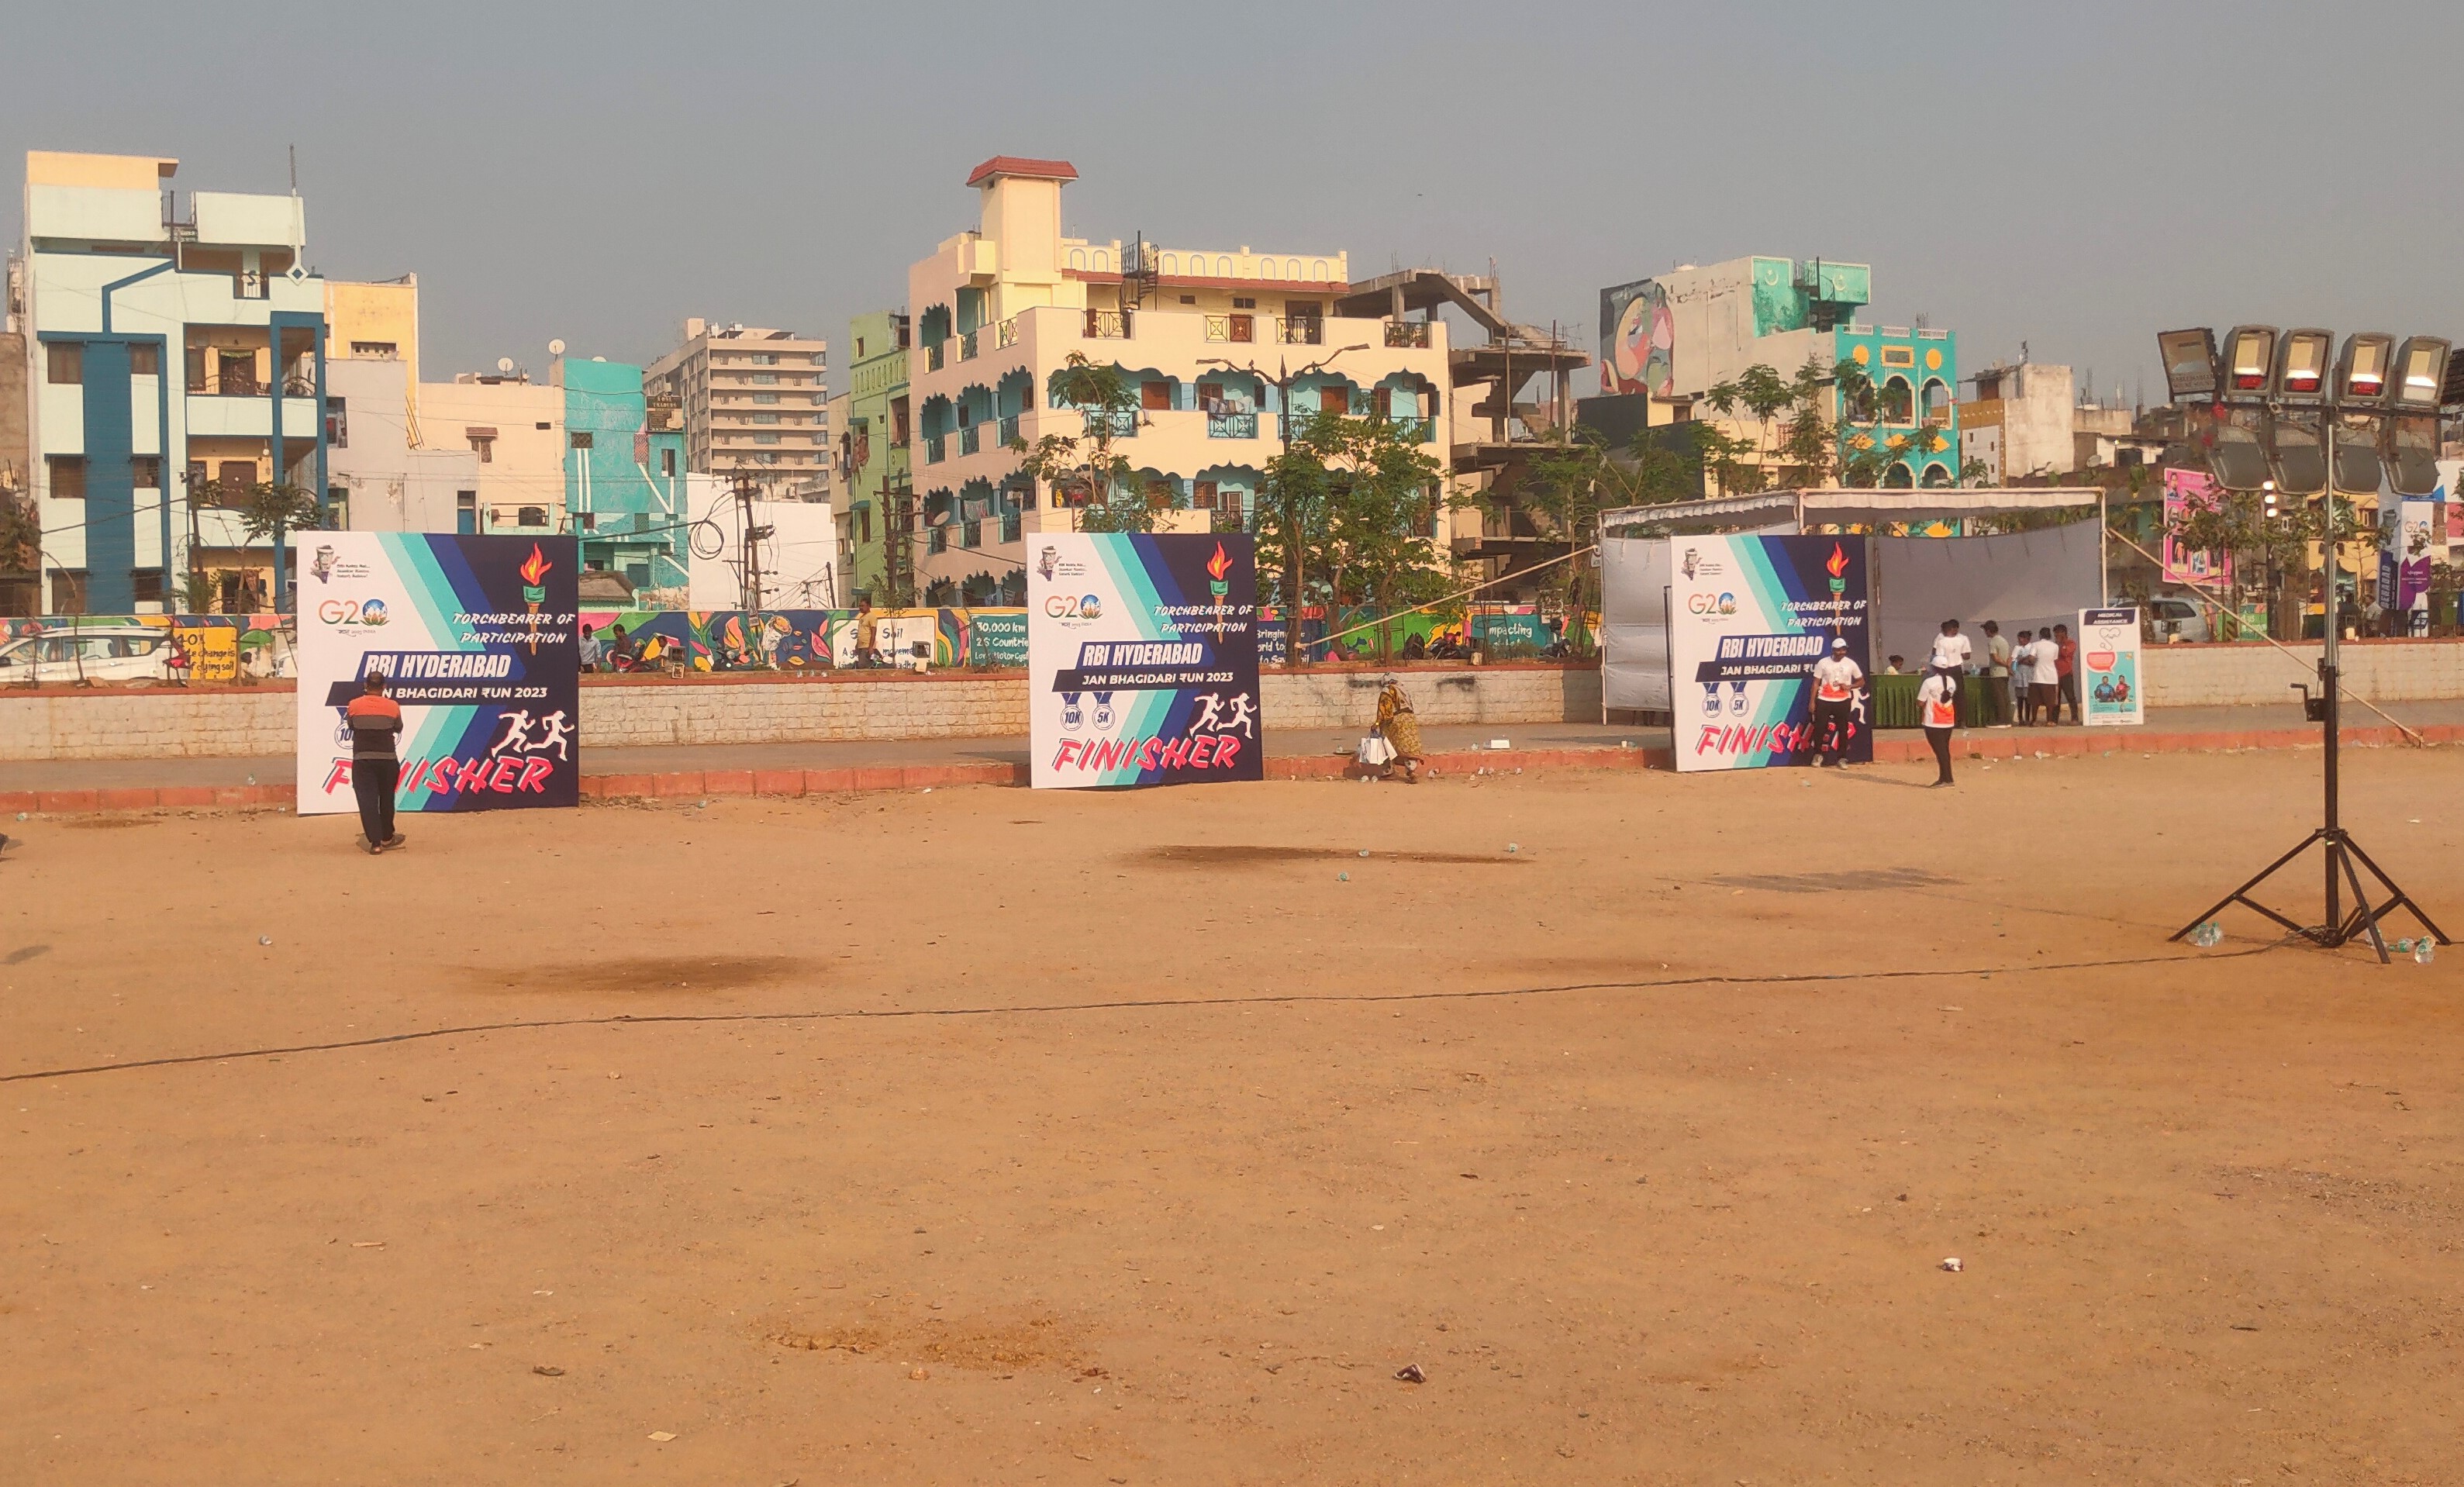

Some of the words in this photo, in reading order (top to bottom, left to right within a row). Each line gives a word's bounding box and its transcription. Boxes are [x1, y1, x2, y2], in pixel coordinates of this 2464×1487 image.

[1154, 605, 1235, 616] TORCHBEARER
[1238, 605, 1254, 616] OF
[1781, 600, 1851, 612] TORCHBEARER
[1854, 600, 1867, 610] OF
[453, 612, 553, 624] TORCHBEARER
[557, 613, 576, 624] OF
[1787, 616, 1862, 627] PARTICIPATION
[1012, 622, 1026, 633] km
[1161, 622, 1248, 633] PARTICIPATION
[1489, 623, 1533, 638] mpacting
[460, 632, 568, 643] PARTICIPATION
[1257, 629, 1286, 641] Bringin
[992, 637, 1029, 647] Countrie
[1258, 640, 1273, 652] orld
[1720, 638, 1744, 658] RBI
[1746, 636, 1824, 658] HYDERABAD
[1082, 644, 1110, 667] RBI
[1112, 643, 1203, 667] HYDERABAD
[363, 654, 399, 678] RBI
[400, 654, 512, 678] HYDERABAD
[1720, 666, 1742, 676] JAN
[1744, 664, 1801, 674] BHAGIDARI
[1082, 674, 1107, 685] JAN
[1109, 673, 1177, 685] BHAGIDARI
[1206, 671, 1234, 682] 2023
[396, 687, 478, 699] BHAGIDARI
[514, 687, 548, 698] 2023
[1705, 699, 1720, 711] 10K
[1734, 699, 1744, 710] 5K
[1065, 711, 1082, 724] 10K
[1097, 711, 1109, 723] 5K
[340, 727, 354, 741] 10
[1052, 734, 1241, 772] FINISHER
[322, 754, 554, 795] FISHER
